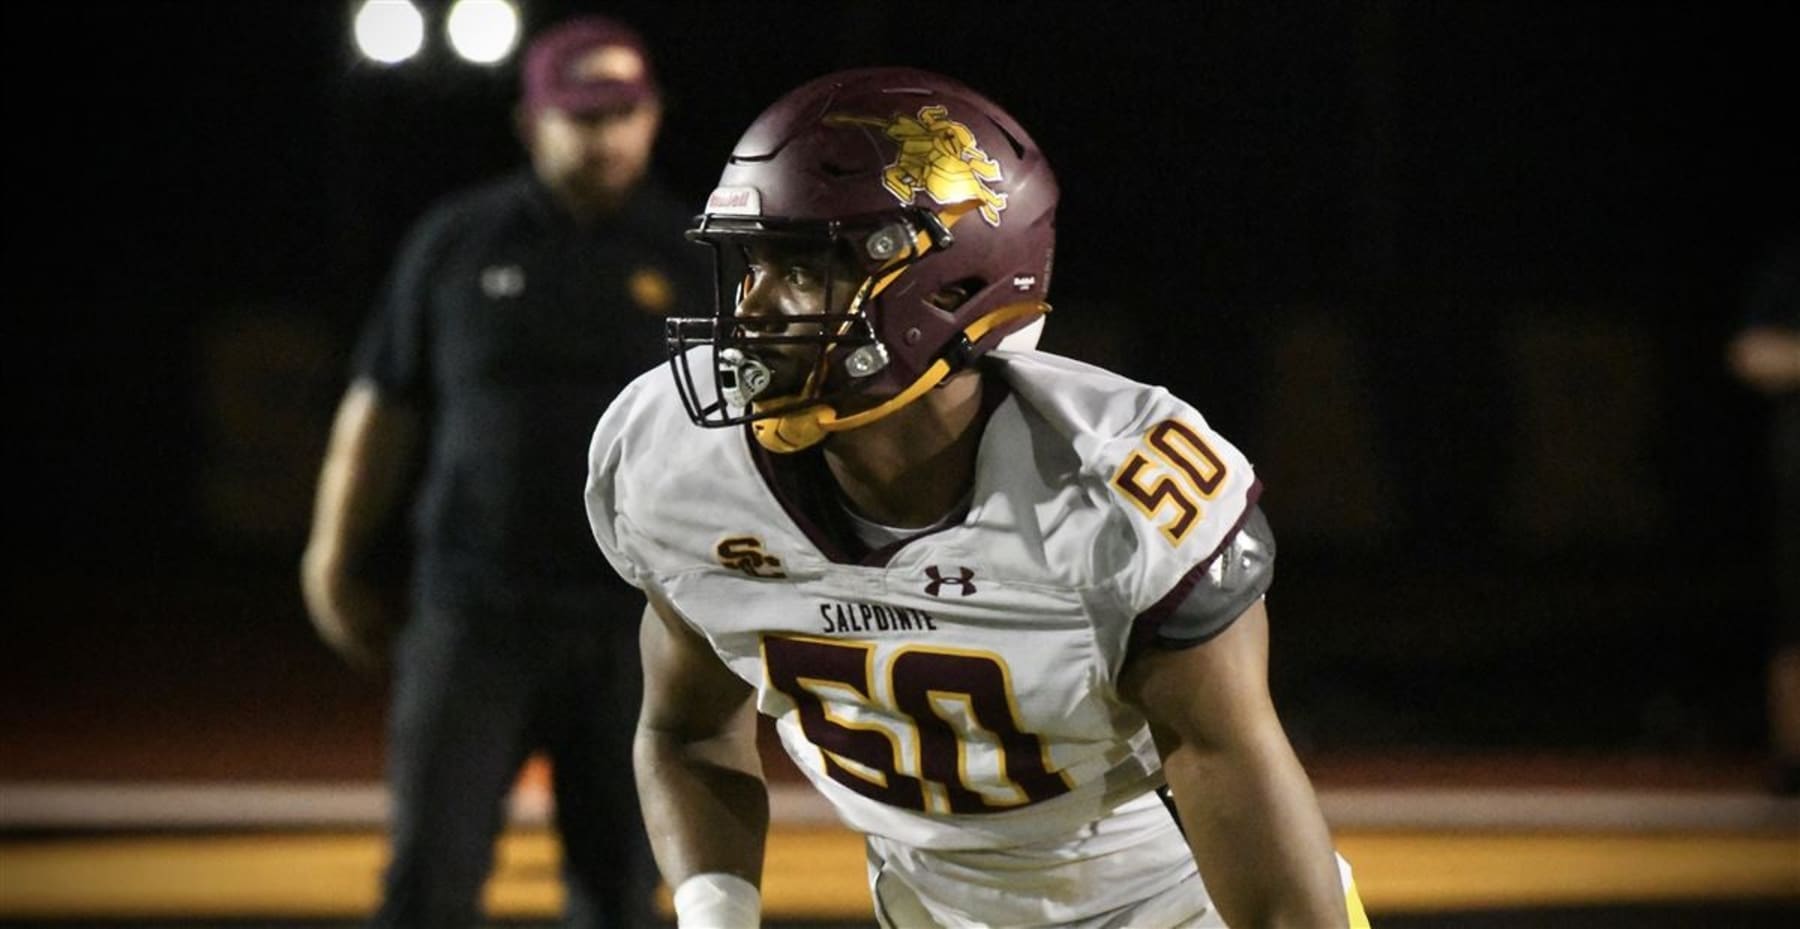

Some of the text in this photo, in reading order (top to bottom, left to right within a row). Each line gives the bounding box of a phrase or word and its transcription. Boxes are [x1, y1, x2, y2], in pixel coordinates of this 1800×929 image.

[1110, 418, 1228, 549] 50
[714, 535, 787, 579] SC
[820, 603, 937, 633] SALPOINTE
[759, 633, 1076, 815] 50
